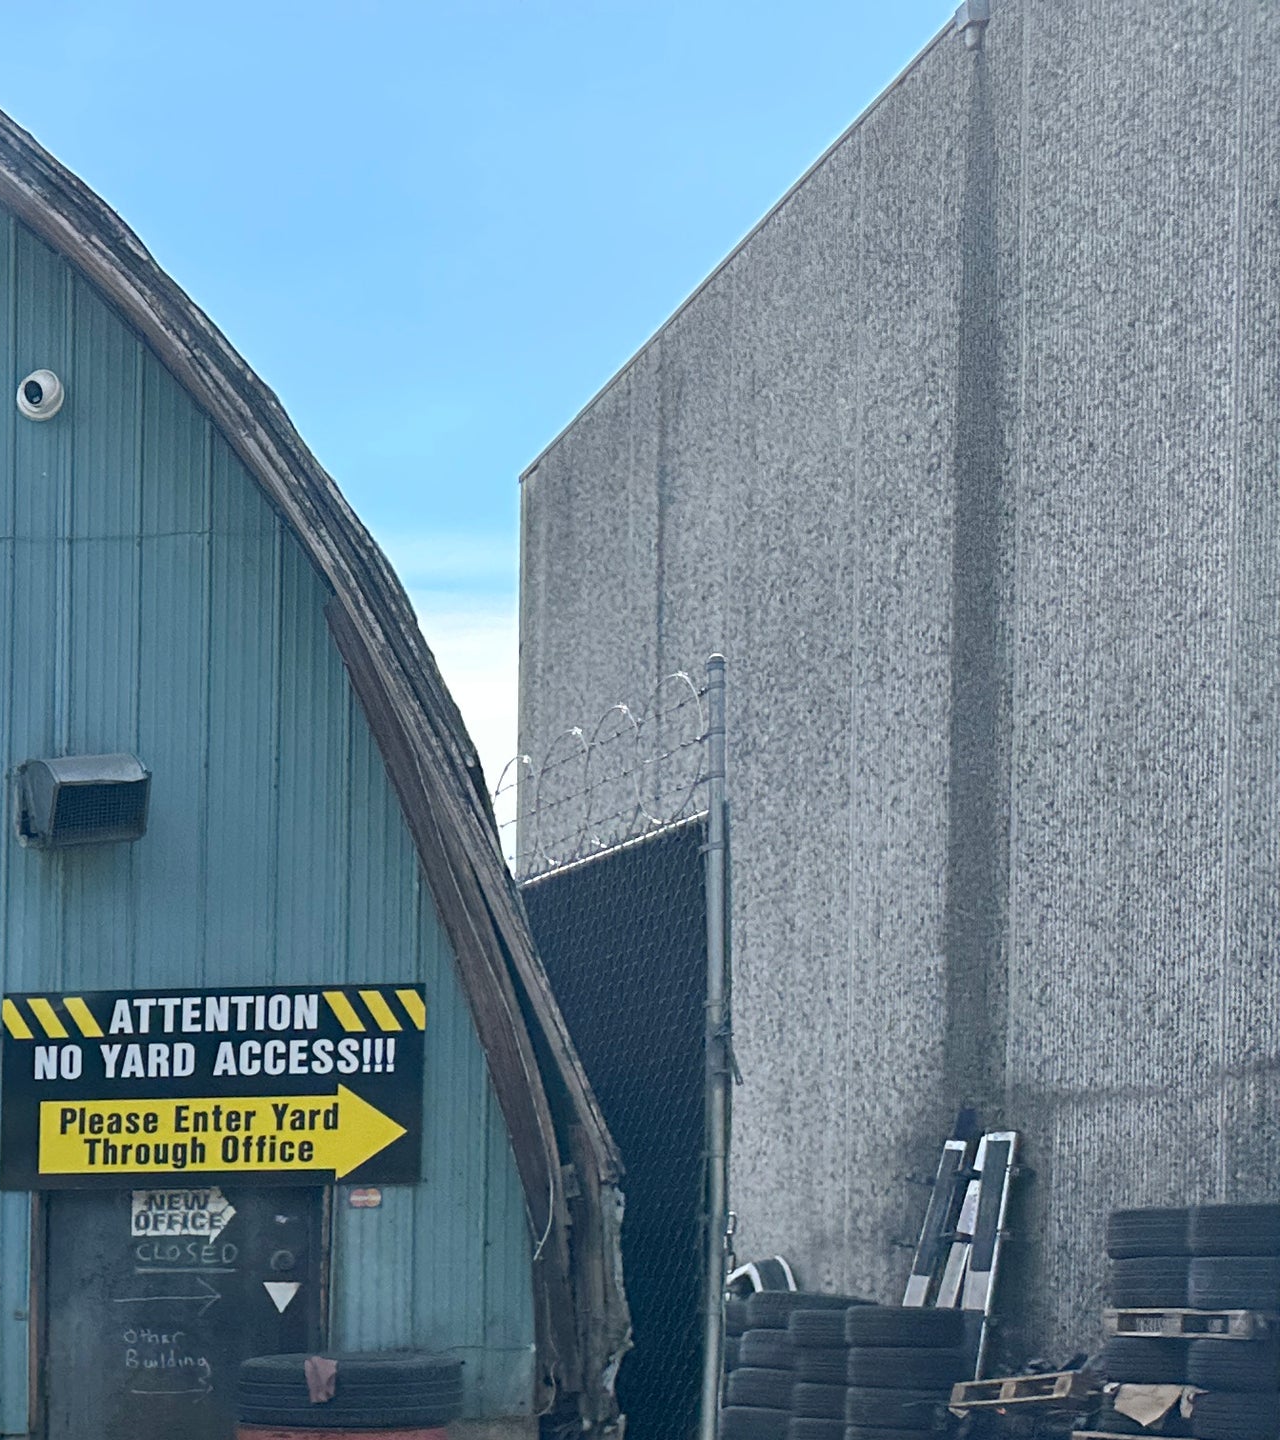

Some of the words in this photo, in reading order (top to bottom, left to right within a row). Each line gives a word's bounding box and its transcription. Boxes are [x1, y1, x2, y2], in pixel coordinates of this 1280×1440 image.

[109, 994, 319, 1034] ATTENTION
[34, 1045, 82, 1080] NO
[101, 1042, 195, 1078] YARD
[213, 1038, 396, 1075] ACCESS!!!
[60, 1107, 158, 1135] Please
[175, 1105, 256, 1133] Enter
[272, 1103, 338, 1131] Yard
[83, 1136, 206, 1169] Through
[222, 1135, 314, 1163] Office
[148, 1191, 210, 1211] NEW
[135, 1211, 225, 1232] OFFICE
[136, 1243, 238, 1264] CLOSED
